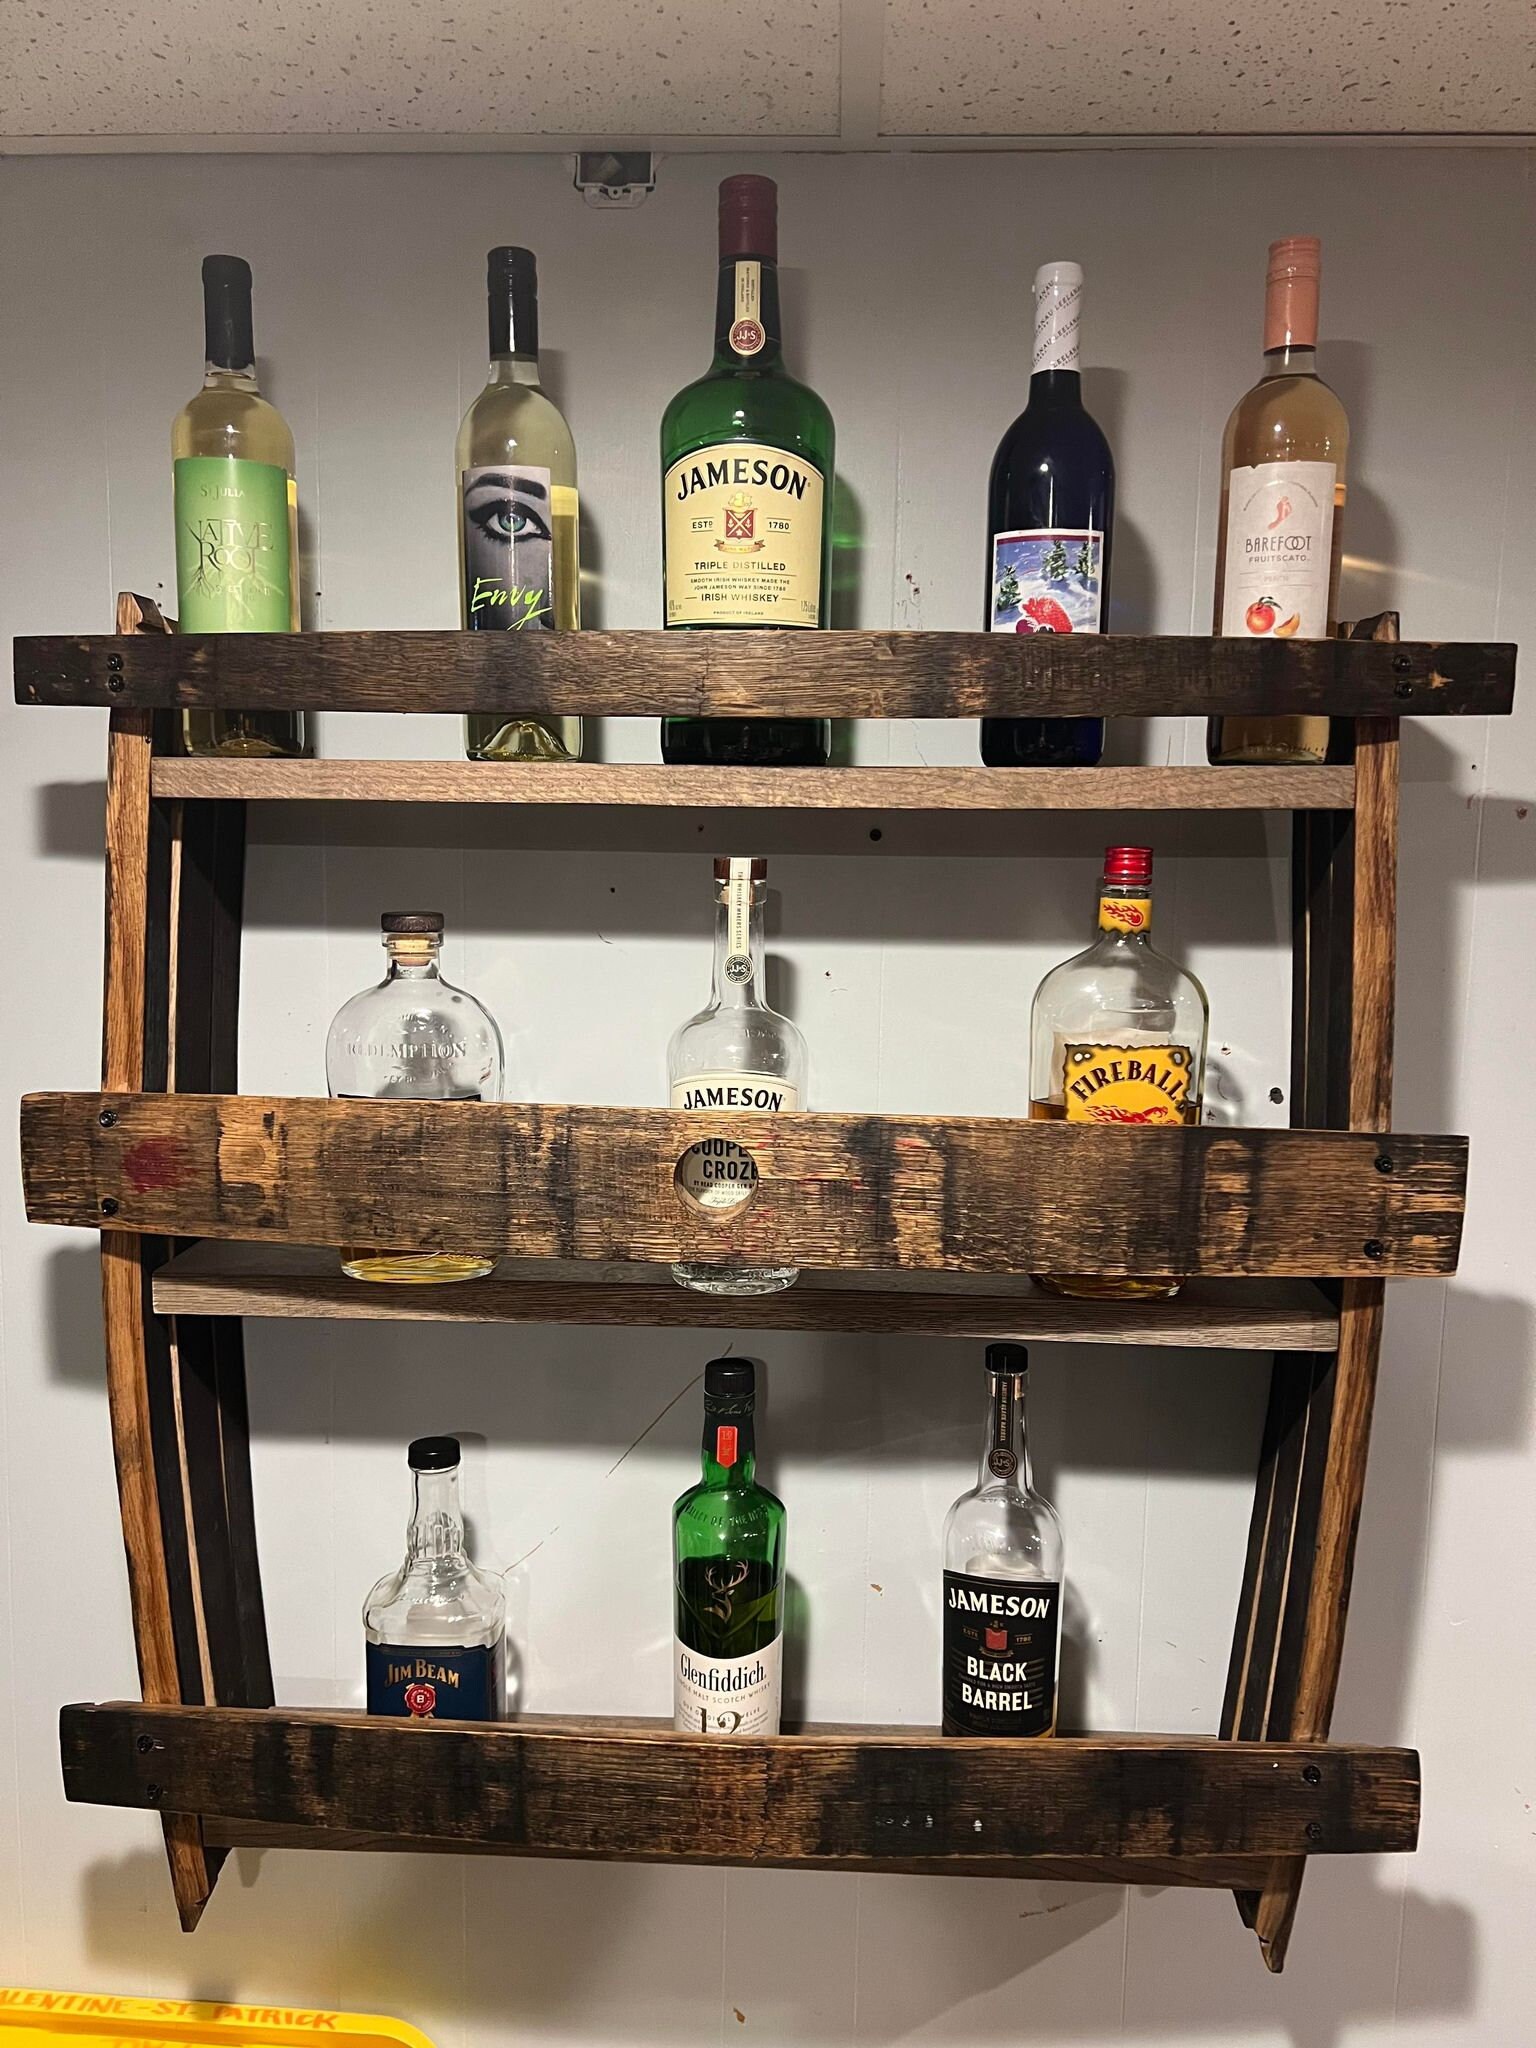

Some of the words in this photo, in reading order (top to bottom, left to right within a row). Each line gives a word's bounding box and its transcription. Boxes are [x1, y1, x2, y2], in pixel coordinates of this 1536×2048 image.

[677, 458, 808, 501] JAMESON
[186, 518, 274, 550] NATIVE
[768, 521, 790, 530] 1780
[199, 541, 268, 574] ROOT
[1245, 535, 1312, 553] BAREFOOT
[694, 561, 728, 570] TRIPLE
[732, 561, 786, 571] DISTILLED
[1249, 554, 1307, 563] FRUITSCATO
[471, 577, 552, 631] Envy
[701, 593, 727, 601] IRISH
[731, 593, 780, 602] WHISKEY
[1069, 1060, 1184, 1103] FIREBALL
[684, 1087, 783, 1112] JAMESON
[948, 1587, 1050, 1619] JAMESON
[384, 1663, 412, 1688] JIM
[415, 1658, 460, 1689] BEAM
[680, 1653, 765, 1693] Glenfiddich
[967, 1655, 1028, 1683] BLACK
[416, 1694, 425, 1703] B
[693, 1690, 709, 1701] MALT
[712, 1695, 746, 1704] SCOTCH
[961, 1682, 1033, 1711] BARREL
[213, 2004, 340, 2031] PATRICK
